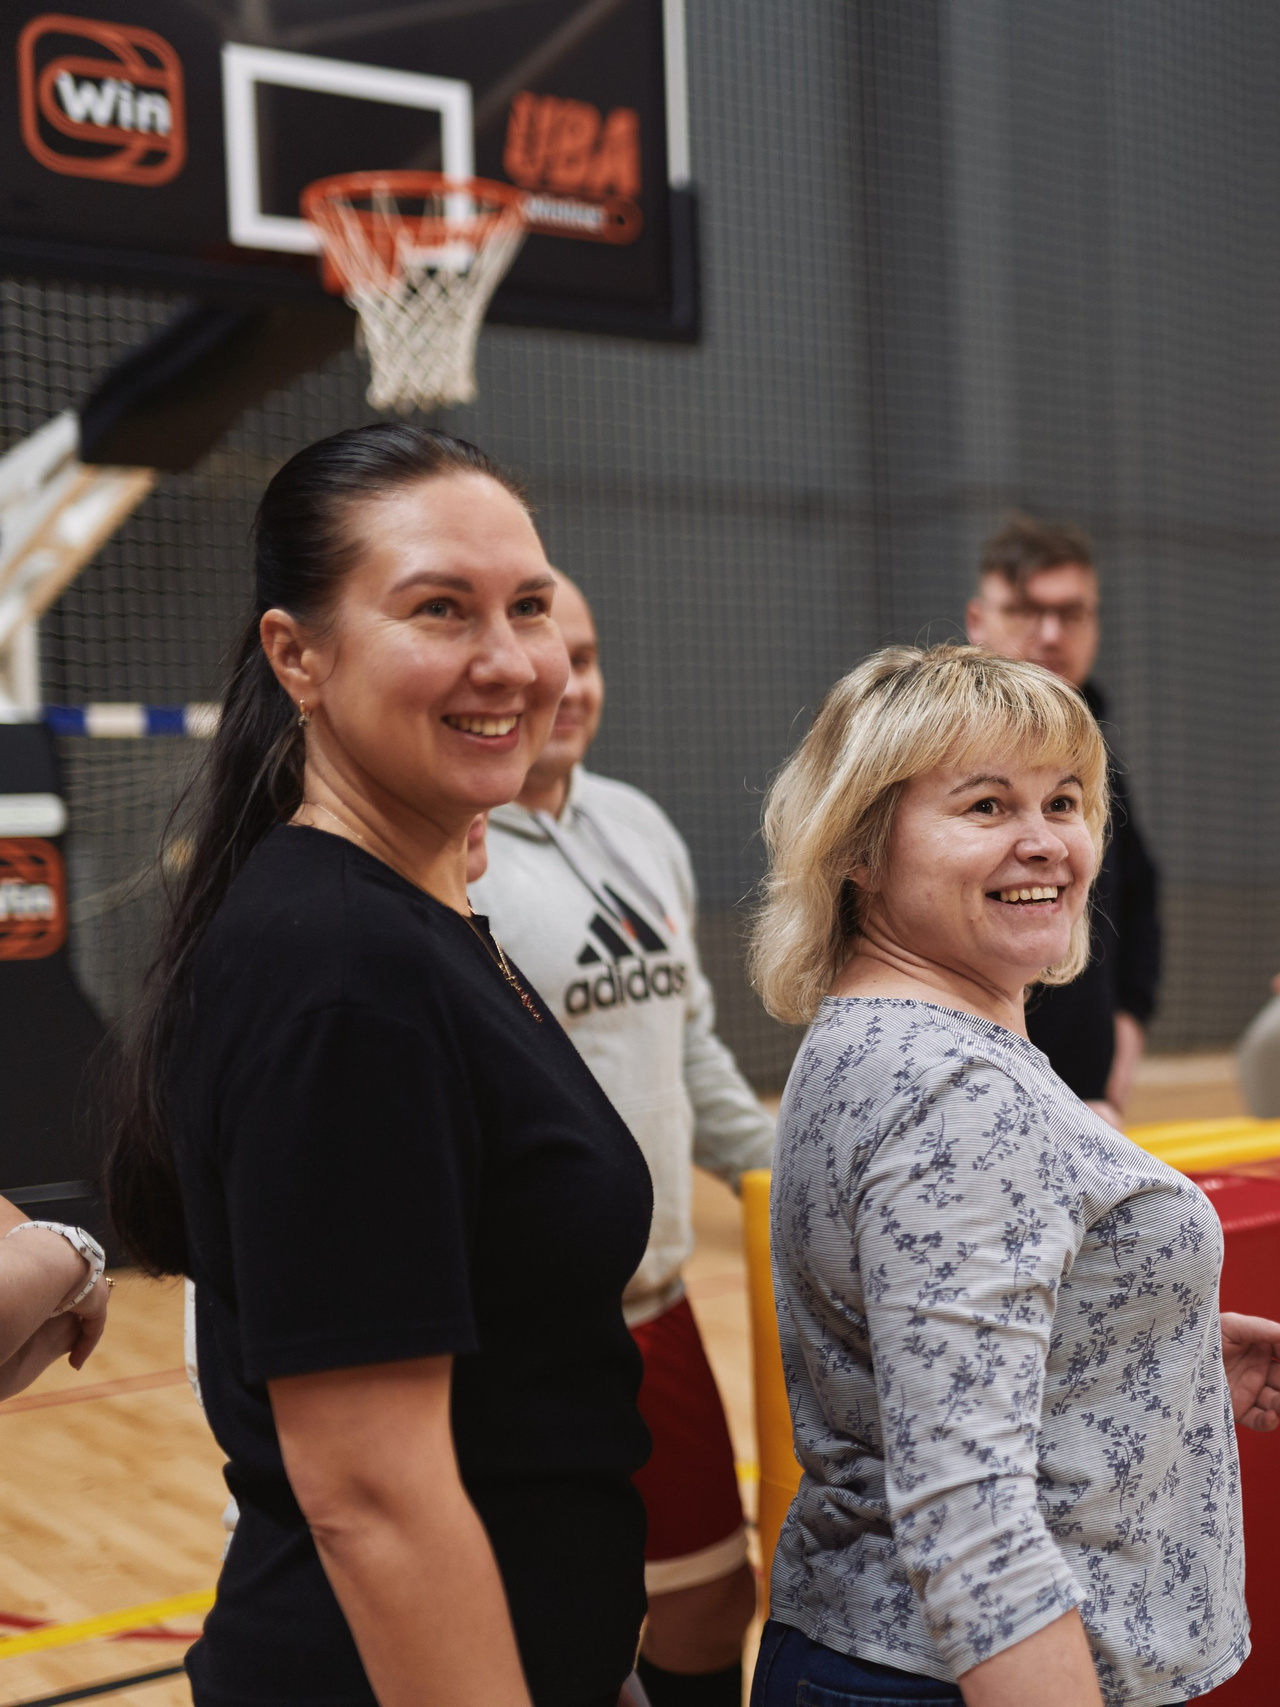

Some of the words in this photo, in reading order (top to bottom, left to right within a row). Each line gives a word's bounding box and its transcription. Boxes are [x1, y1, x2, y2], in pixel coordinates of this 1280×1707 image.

[56, 69, 171, 137] Win
[503, 91, 641, 198] UBA
[564, 957, 686, 1016] adidas
